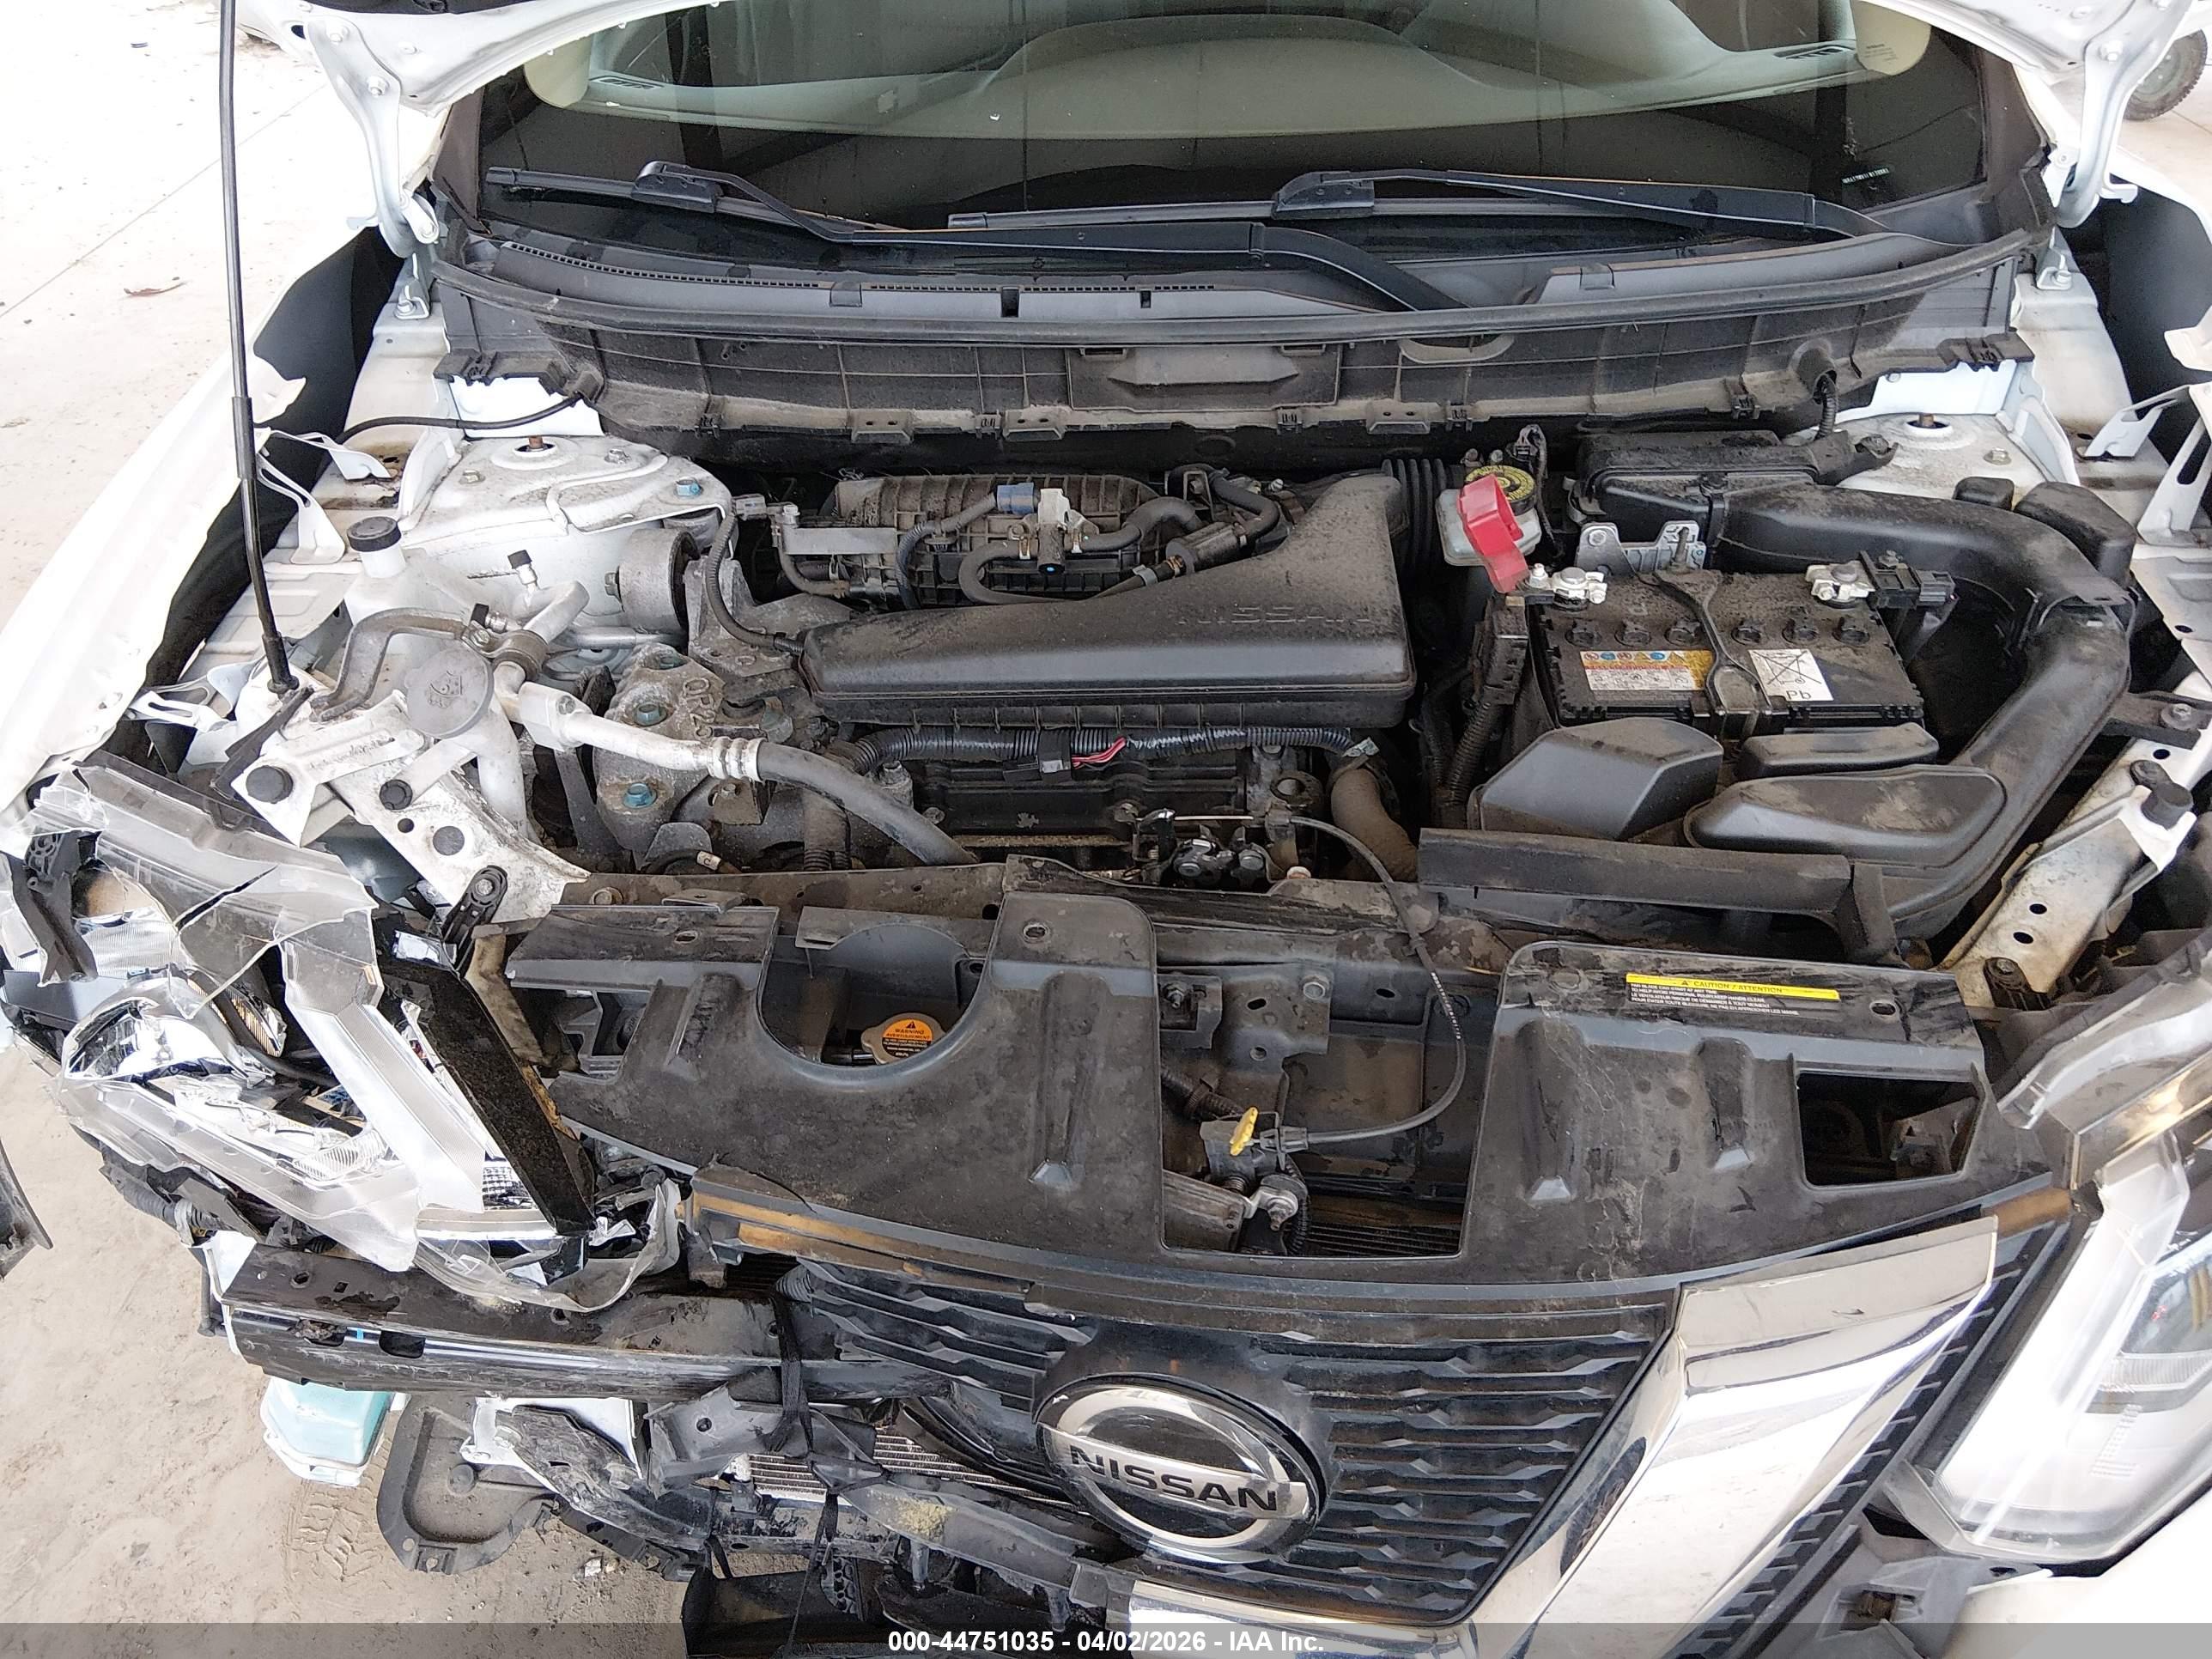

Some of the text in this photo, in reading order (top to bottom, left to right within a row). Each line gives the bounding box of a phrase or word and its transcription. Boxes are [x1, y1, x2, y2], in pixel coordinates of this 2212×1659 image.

[1786, 690, 1812, 700] Pb
[1693, 981, 1729, 989] CAUTION
[1738, 985, 1782, 994] ATTENTION
[1069, 1445, 1277, 1511] NISSAN
